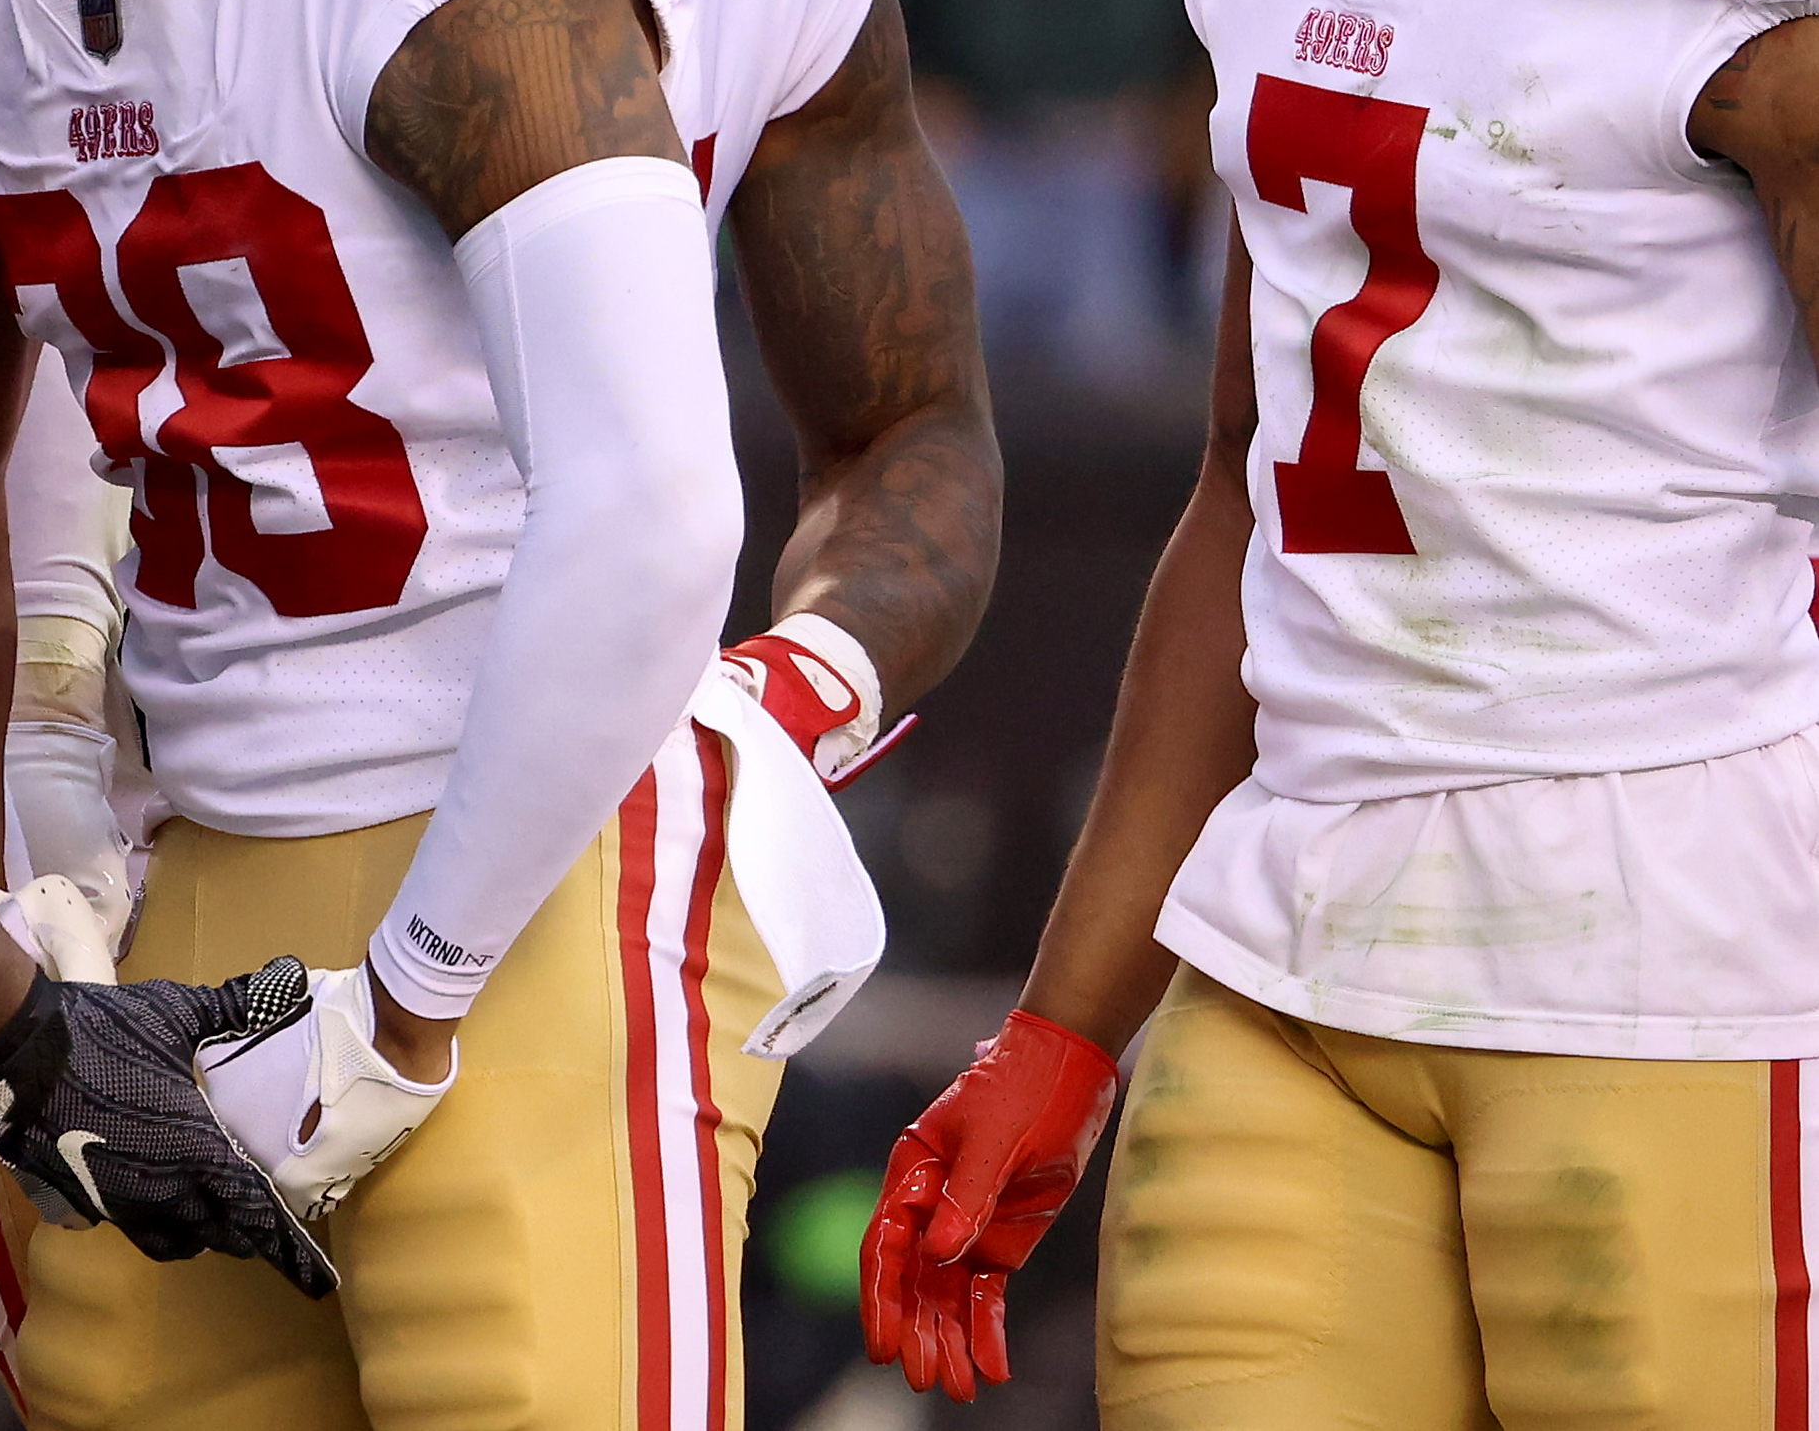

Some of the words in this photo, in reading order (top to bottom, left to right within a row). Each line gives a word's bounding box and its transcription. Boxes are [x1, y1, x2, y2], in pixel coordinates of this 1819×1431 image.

[1295, 7, 1395, 77] 49ERS
[69, 101, 160, 162] 49ERS
[1245, 73, 1439, 556] 7
[406, 913, 464, 966] NXTRND
